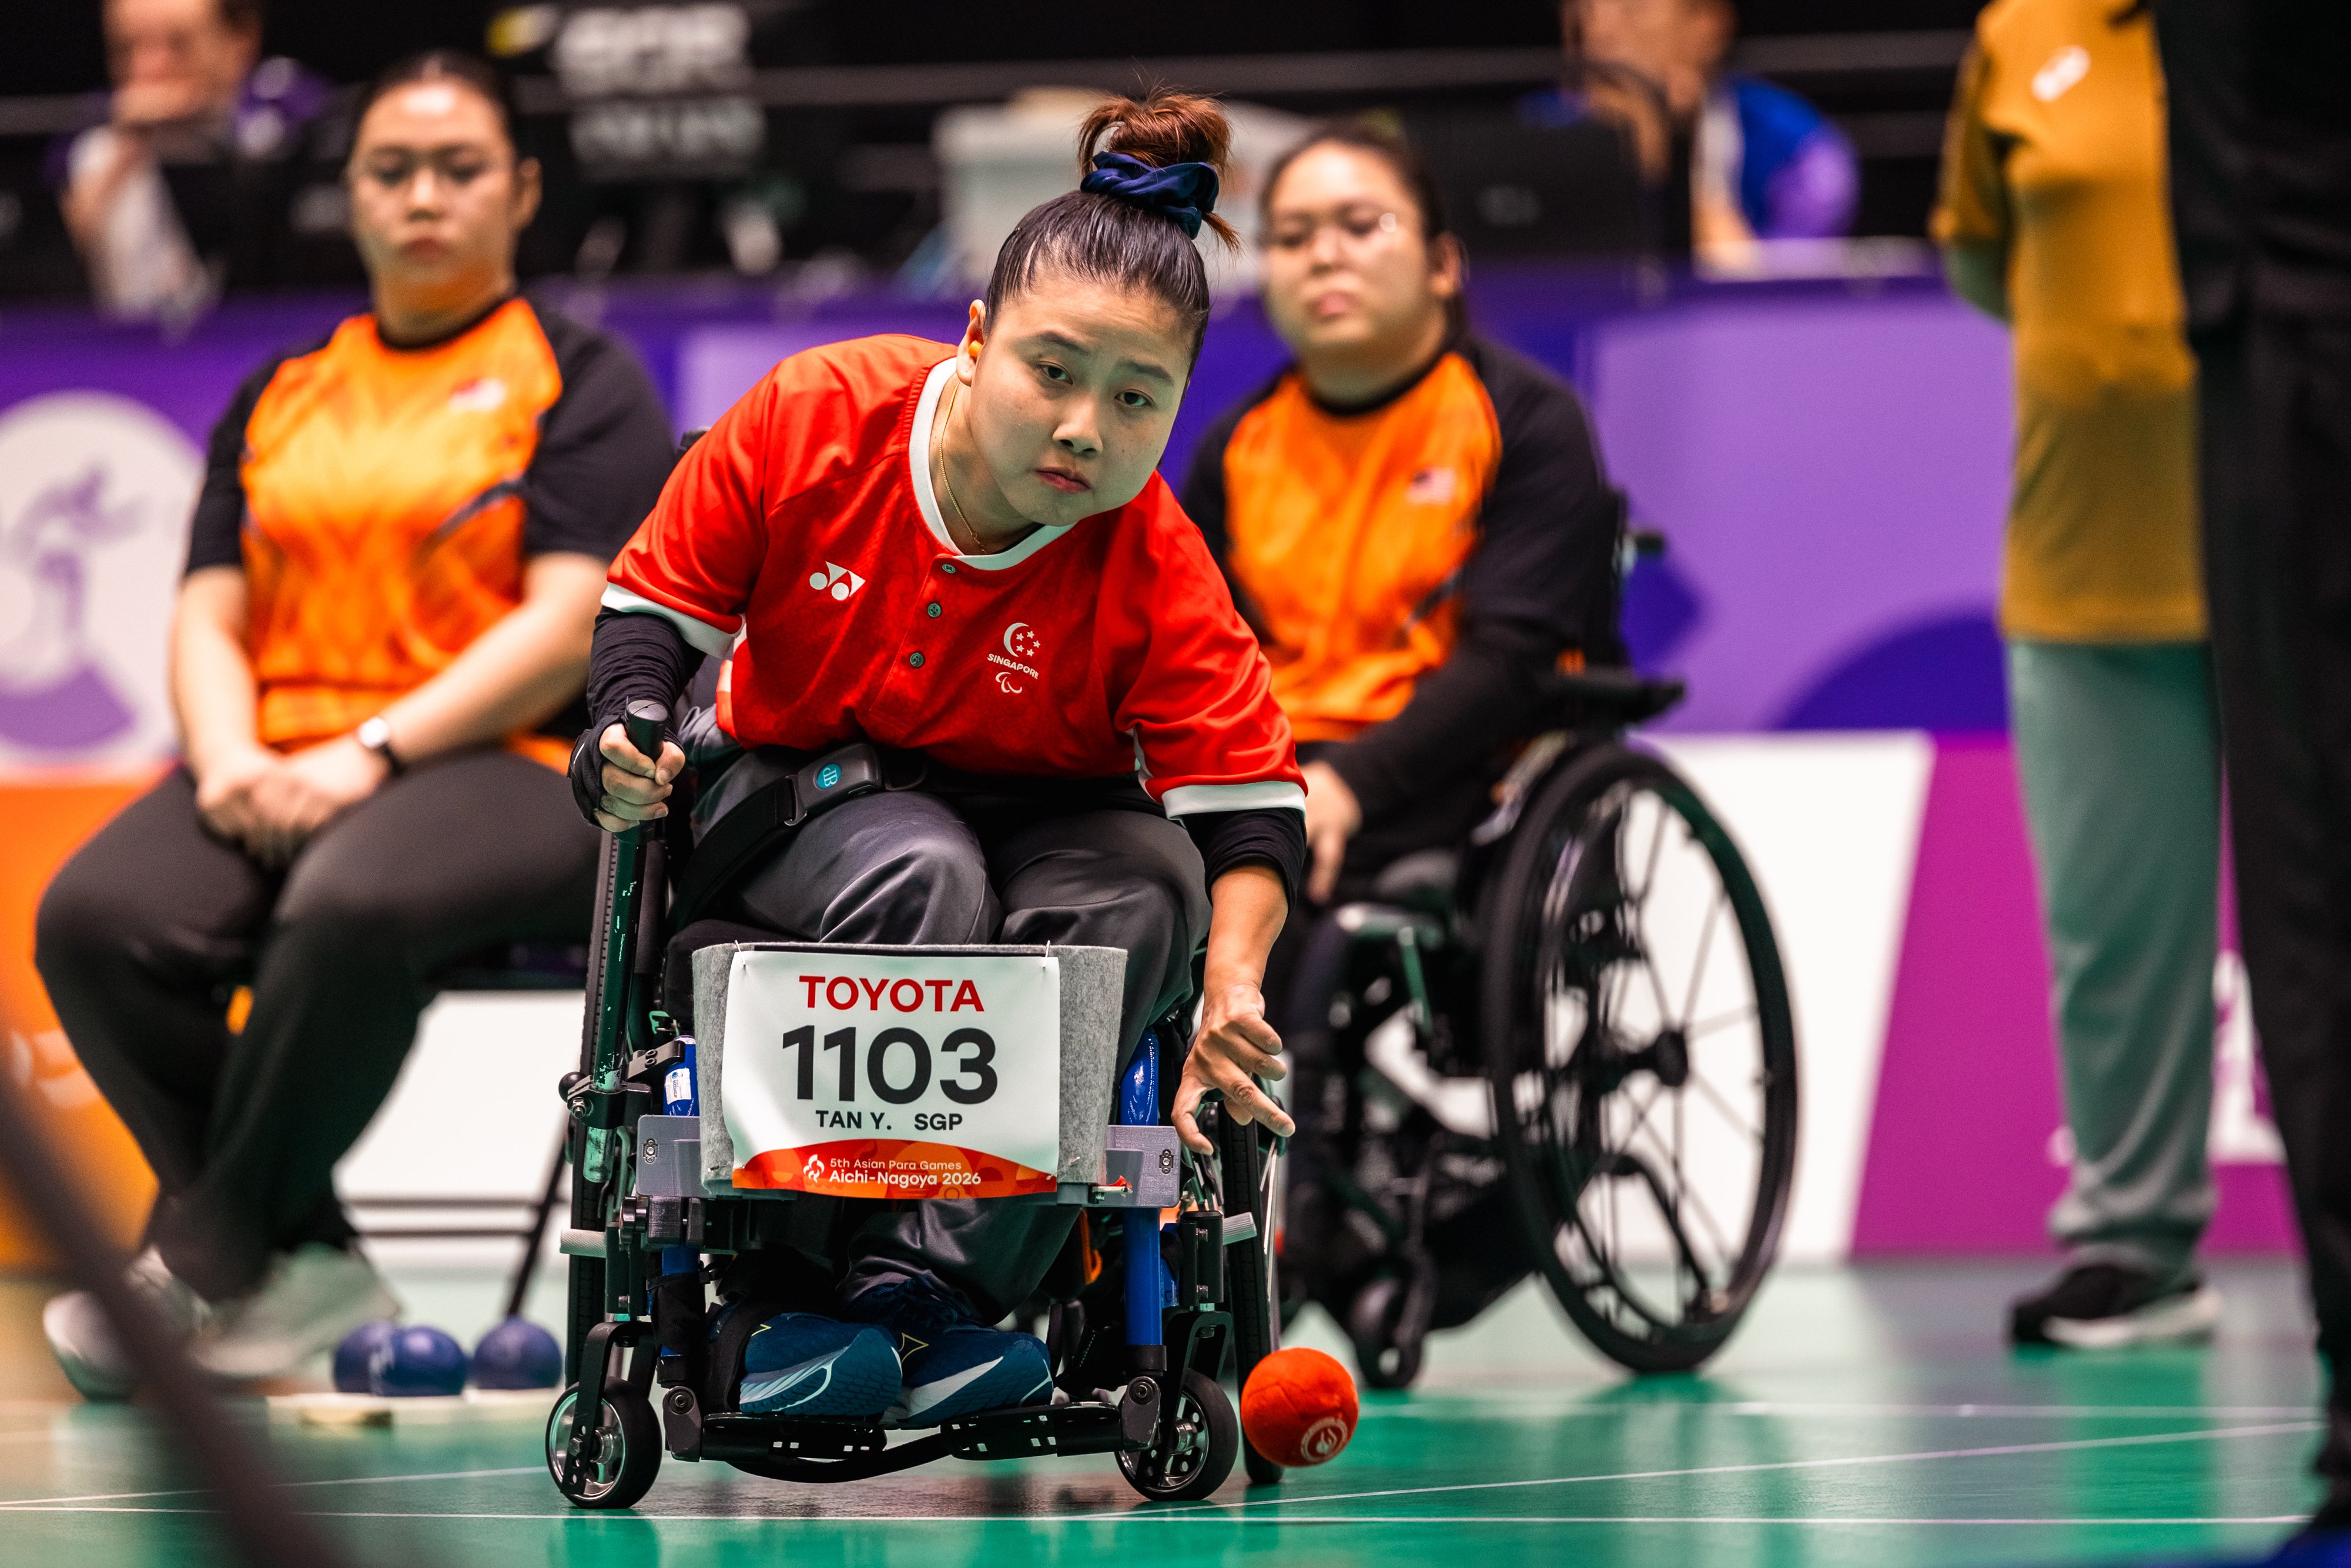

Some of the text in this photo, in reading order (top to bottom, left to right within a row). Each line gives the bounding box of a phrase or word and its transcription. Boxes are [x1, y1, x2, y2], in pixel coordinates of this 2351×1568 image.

[987, 653, 1039, 679] SINGAPORE
[799, 975, 984, 1013] TOYOTA
[782, 1024, 998, 1105] 1103
[815, 1110, 963, 1131] TAN Y. SGP
[830, 1158, 962, 1170] 5th Asian Para Games
[829, 1170, 982, 1189] Aichi-Nagoya 2026
